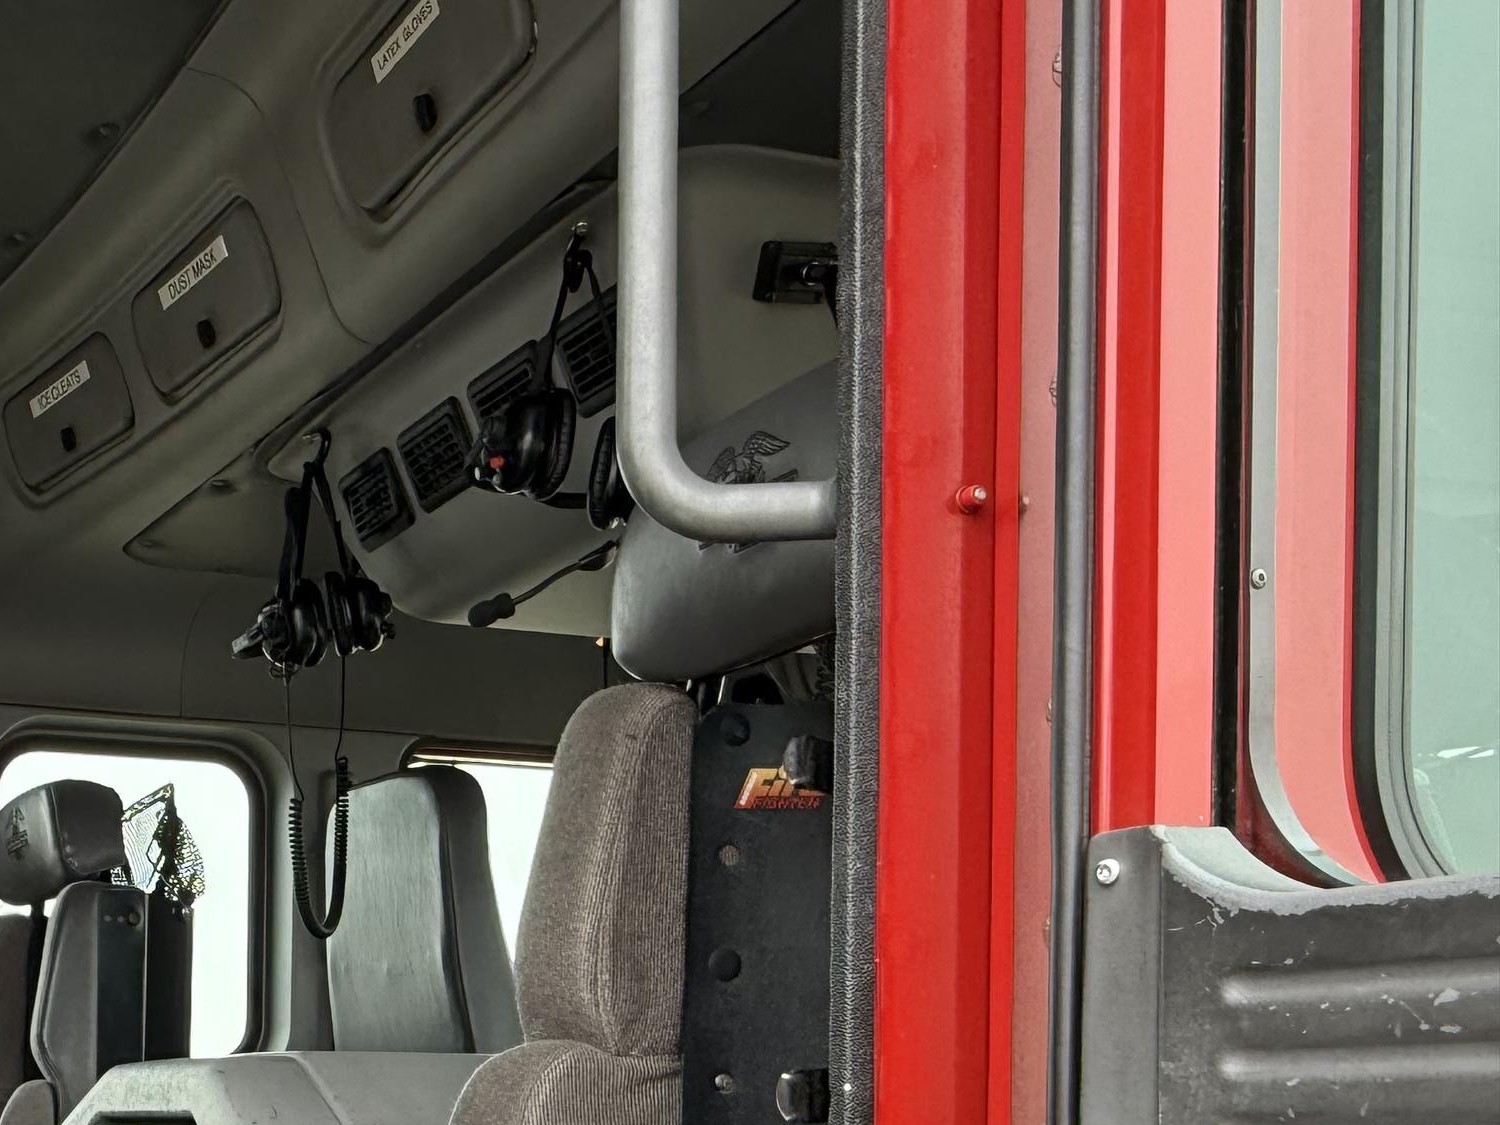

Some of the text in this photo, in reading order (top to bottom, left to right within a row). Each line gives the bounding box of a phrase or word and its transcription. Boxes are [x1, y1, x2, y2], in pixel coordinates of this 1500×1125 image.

[377, 0, 433, 70] LATEX GLOVES
[167, 247, 217, 300] DUST MASK
